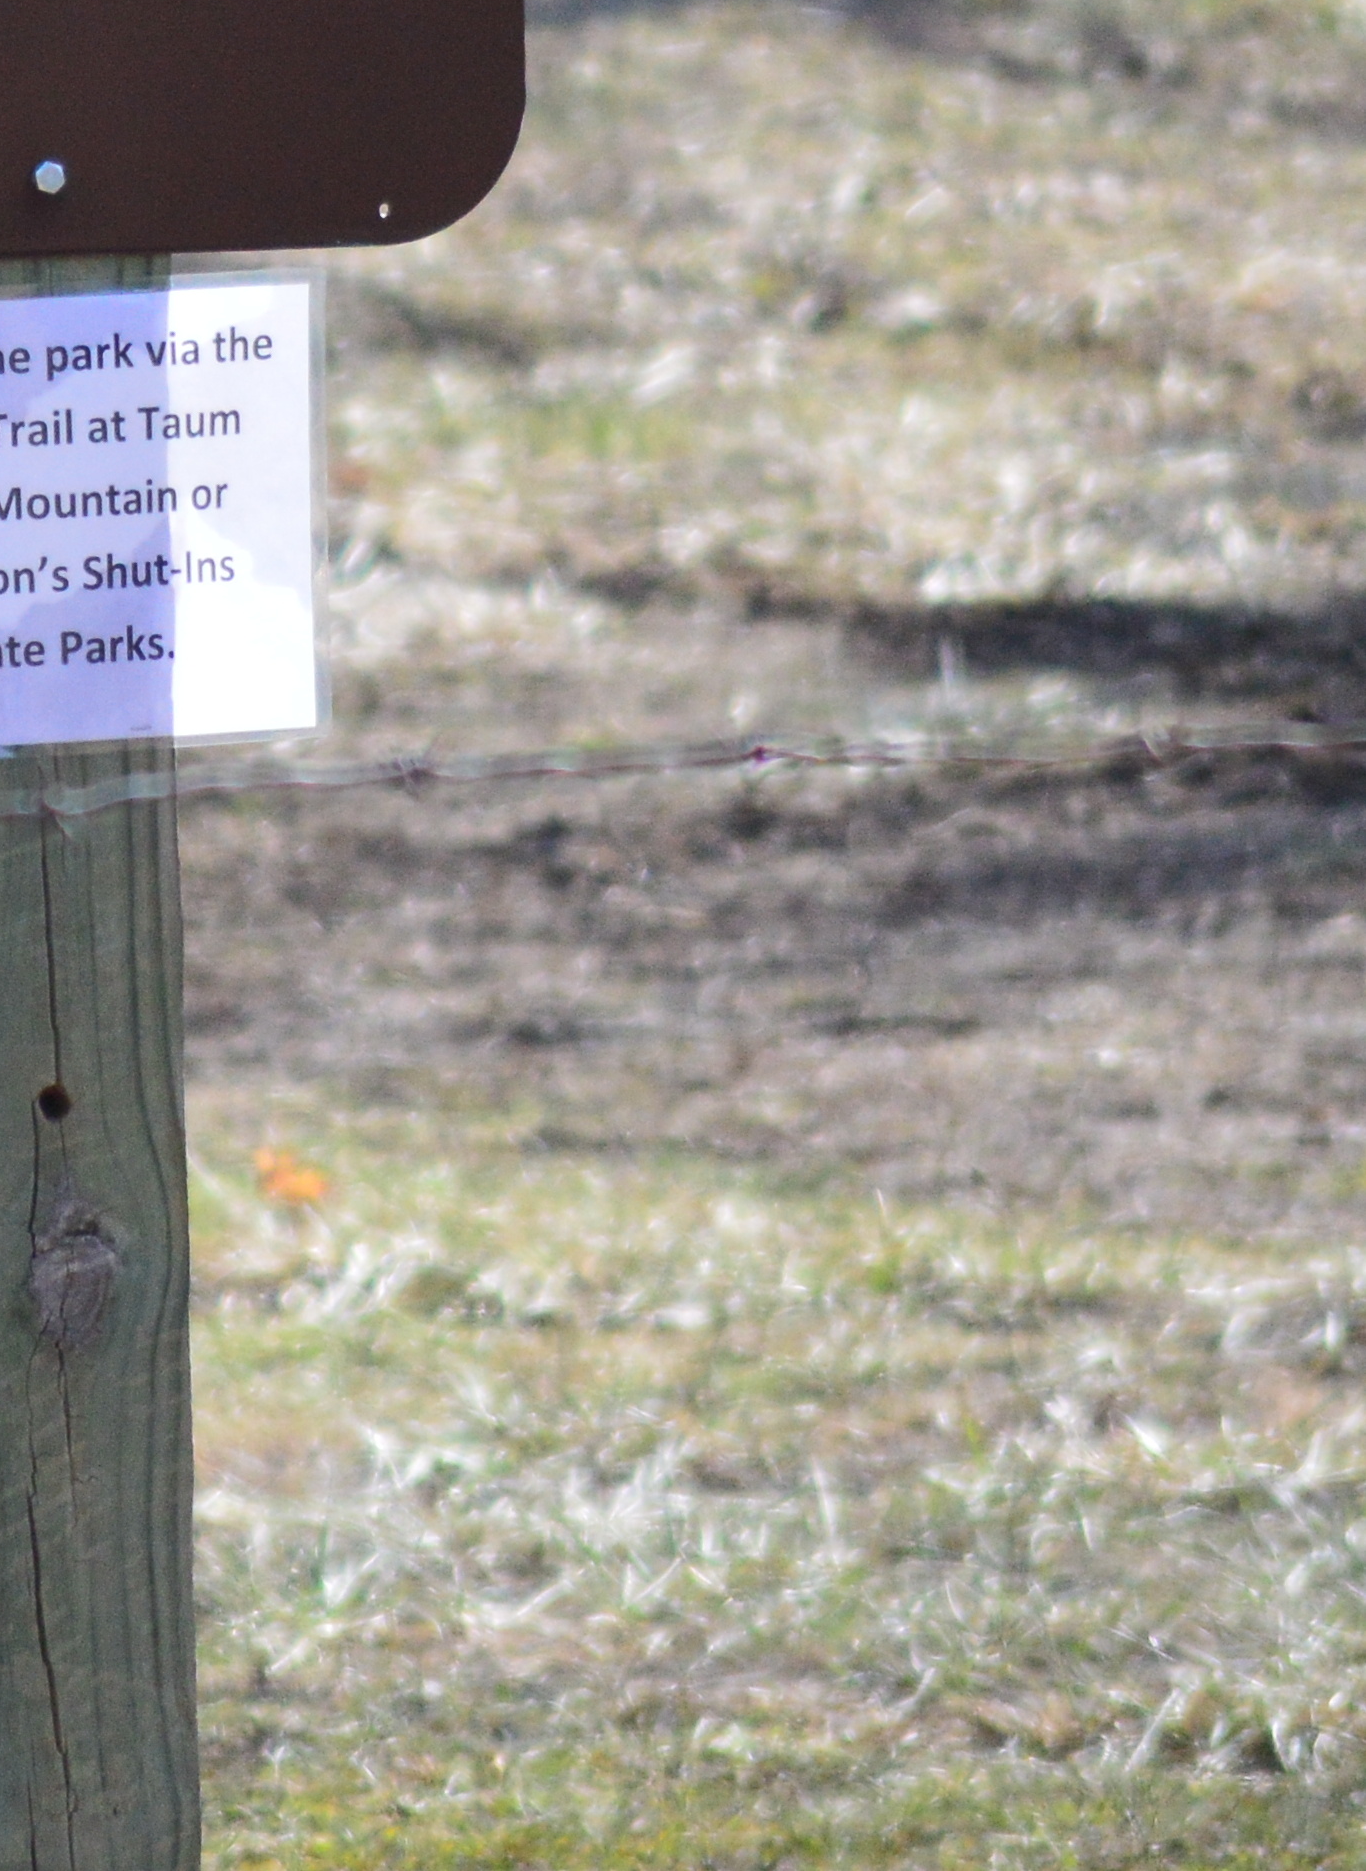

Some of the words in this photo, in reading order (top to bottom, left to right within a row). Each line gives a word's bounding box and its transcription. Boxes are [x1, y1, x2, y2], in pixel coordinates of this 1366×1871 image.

[45, 333, 134, 381] park
[144, 331, 200, 367] via
[213, 326, 273, 363] the
[87, 410, 126, 443] at
[138, 406, 241, 439] Taum
[192, 480, 227, 511] or
[83, 551, 235, 590] Shut-Ins
[60, 625, 175, 666] Parks.
